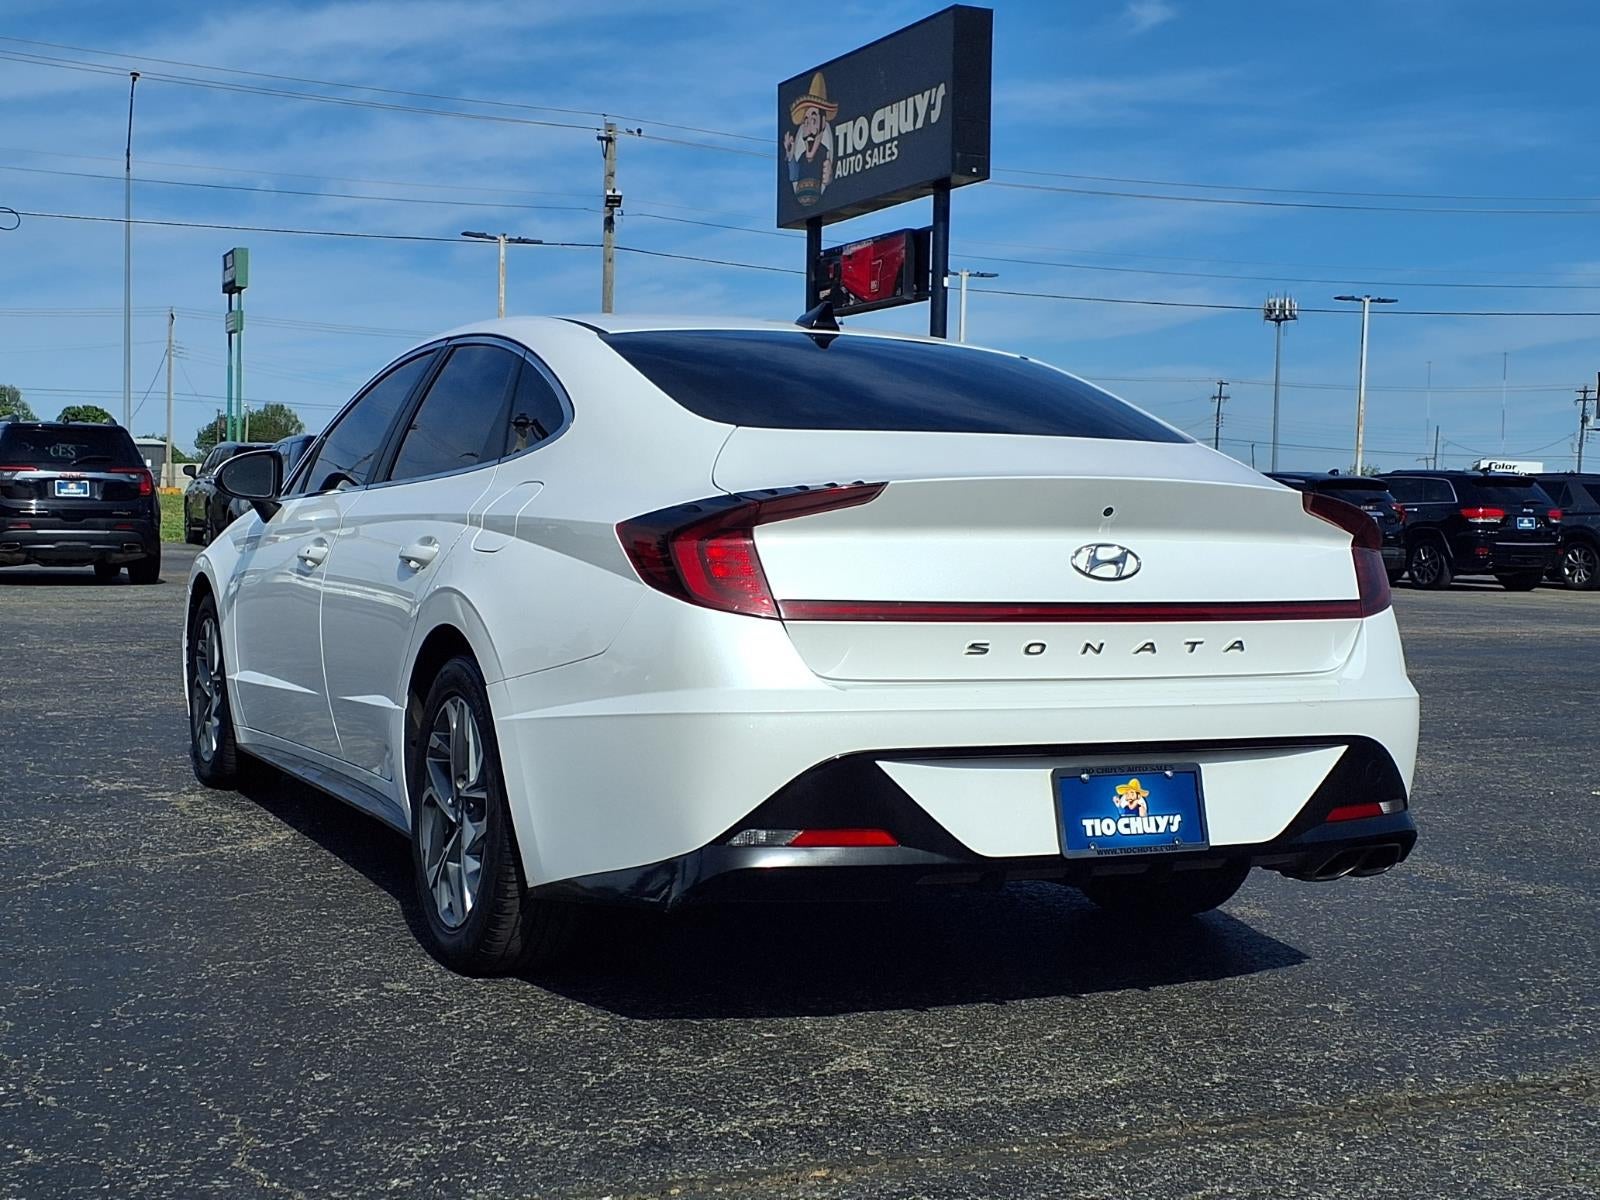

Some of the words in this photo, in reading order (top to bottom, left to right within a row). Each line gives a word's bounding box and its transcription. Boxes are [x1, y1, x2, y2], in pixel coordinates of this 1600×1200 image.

[835, 116, 869, 157] TIO
[870, 82, 946, 144] CHUY'S
[835, 154, 863, 179] AUTO
[865, 140, 899, 170] SALES
[964, 640, 1246, 656] SONATA
[1081, 767, 1094, 775] TIO
[1127, 765, 1148, 773] AUTO
[1151, 764, 1174, 772] SALES
[1082, 818, 1116, 837] TIO
[1117, 814, 1182, 835] CHUY'S
